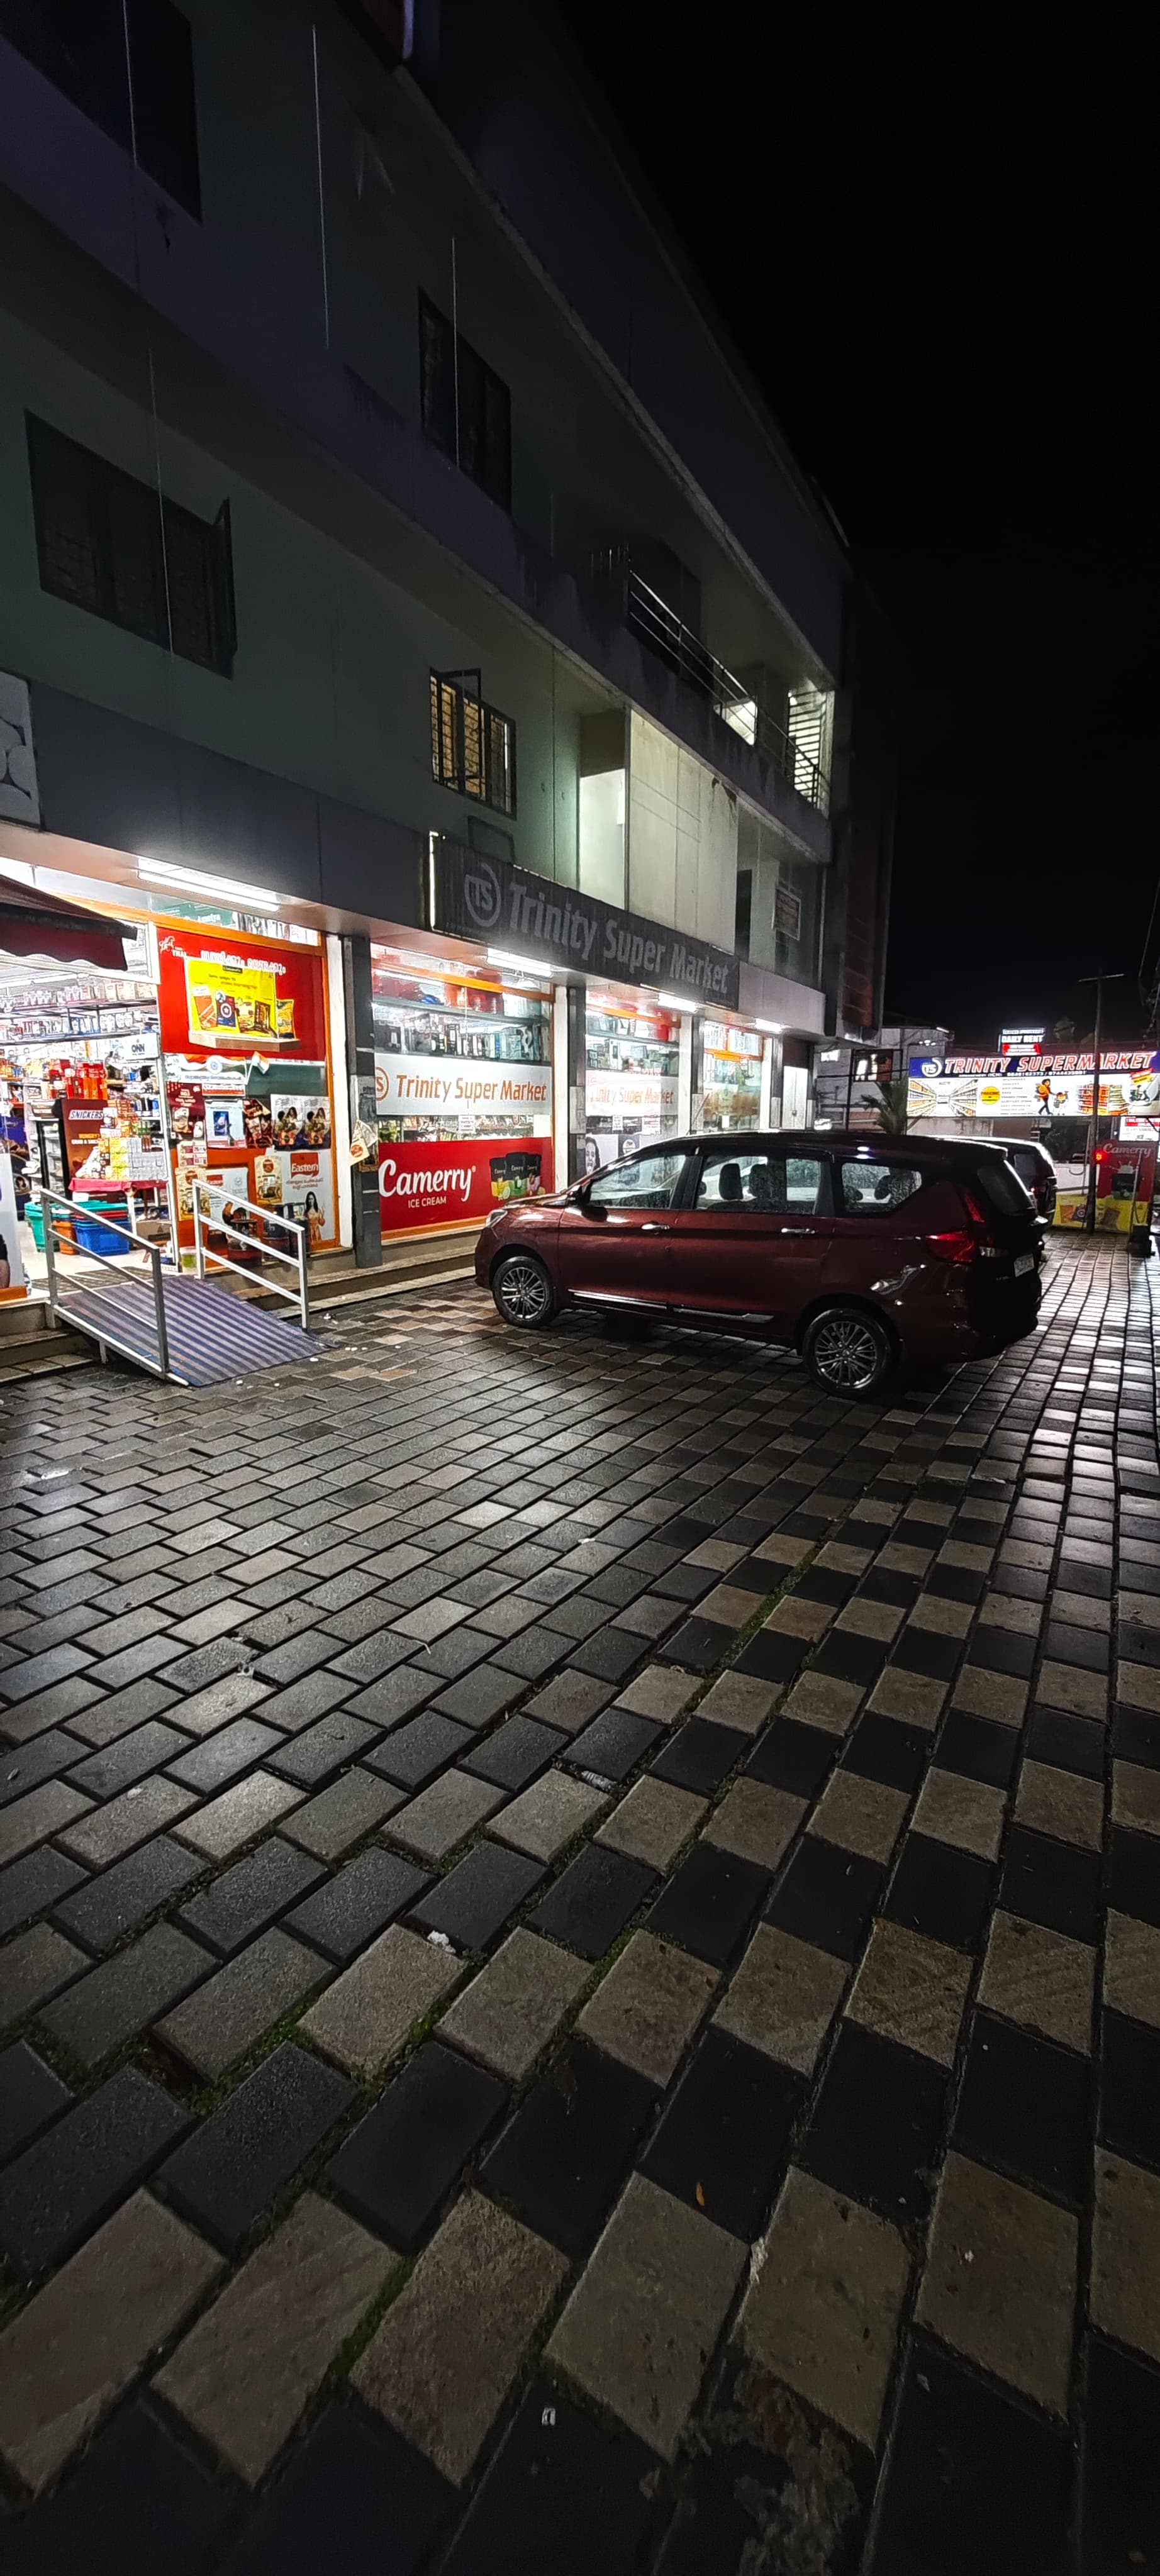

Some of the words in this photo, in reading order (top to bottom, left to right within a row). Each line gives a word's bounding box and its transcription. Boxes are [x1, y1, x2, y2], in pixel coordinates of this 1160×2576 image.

[508, 881, 598, 961] Trinity
[603, 919, 667, 974] Super
[669, 943, 729, 994] Market
[131, 1043, 145, 1053] ONN
[945, 1057, 1012, 1074] TRINITY
[396, 1074, 452, 1102] Trinity
[454, 1077, 498, 1104] Super
[500, 1079, 547, 1101] Market
[588, 1086, 617, 1106] inity
[70, 1111, 104, 1119] SNICKERS
[1102, 1143, 1151, 1157] Camerry
[291, 1163, 318, 1173] Eastern
[378, 1158, 472, 1202] Camerry
[408, 1198, 420, 1208] ICE
[421, 1196, 447, 1207] CREAM
